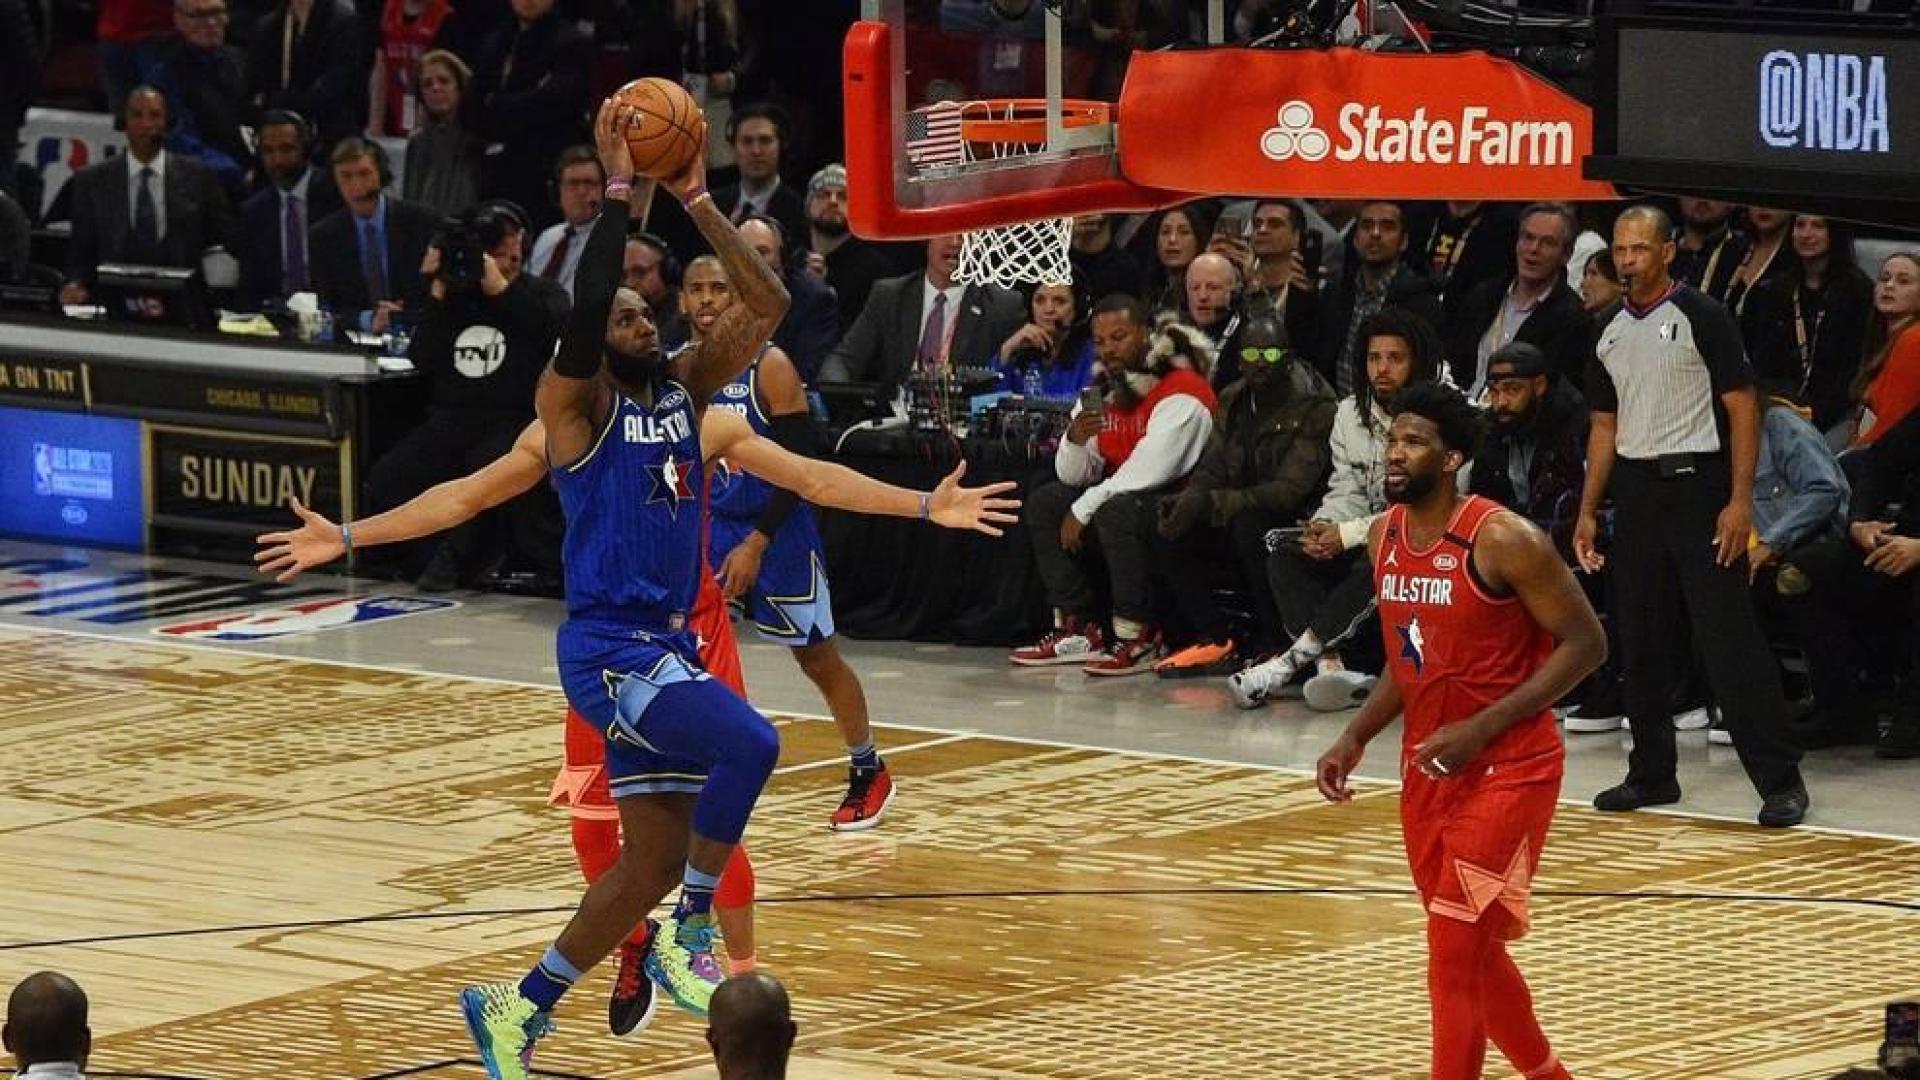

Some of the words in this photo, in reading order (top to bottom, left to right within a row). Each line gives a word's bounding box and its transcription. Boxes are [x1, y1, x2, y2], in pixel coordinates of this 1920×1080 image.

[1760, 50, 1890, 152] @NBA
[15, 365, 40, 389] ON
[44, 368, 75, 393] TNT
[177, 454, 317, 508] SUNDAY
[1381, 574, 1453, 606] ALL-STAR
